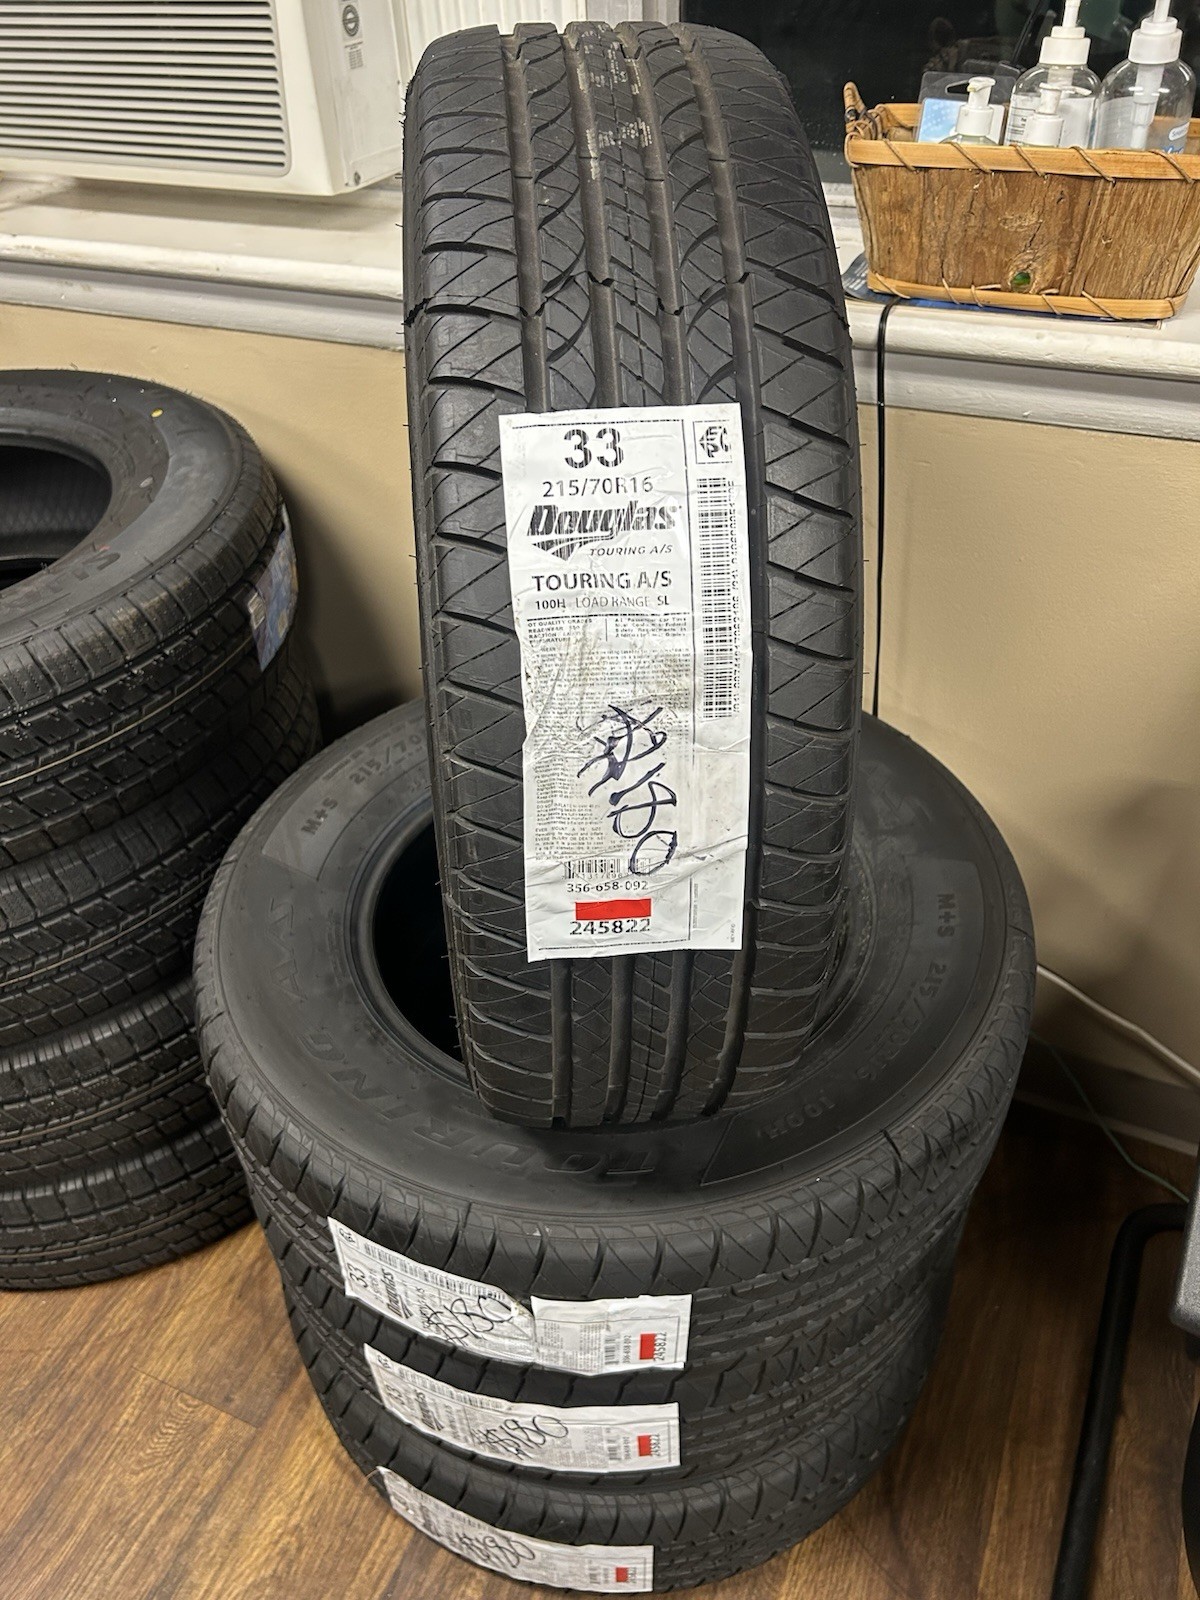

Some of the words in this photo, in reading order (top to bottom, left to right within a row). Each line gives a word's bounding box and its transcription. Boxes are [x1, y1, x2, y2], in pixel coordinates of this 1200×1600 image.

[563, 427, 624, 469] 33
[542, 476, 654, 498] 215/70R16
[526, 500, 678, 538] Douglas
[589, 545, 646, 557] TOURING
[649, 544, 673, 554] A/S
[531, 572, 631, 592] TOURING
[637, 570, 673, 588] A/S
[535, 598, 566, 611] 100H
[575, 596, 609, 609] LOAD
[611, 595, 650, 608] RANGE
[657, 594, 670, 606] SL
[300, 797, 338, 836] M+S
[566, 880, 649, 893] 356-658-092
[569, 918, 651, 935] 245822
[936, 892, 957, 939] M+S
[346, 1262, 369, 1289] 33
